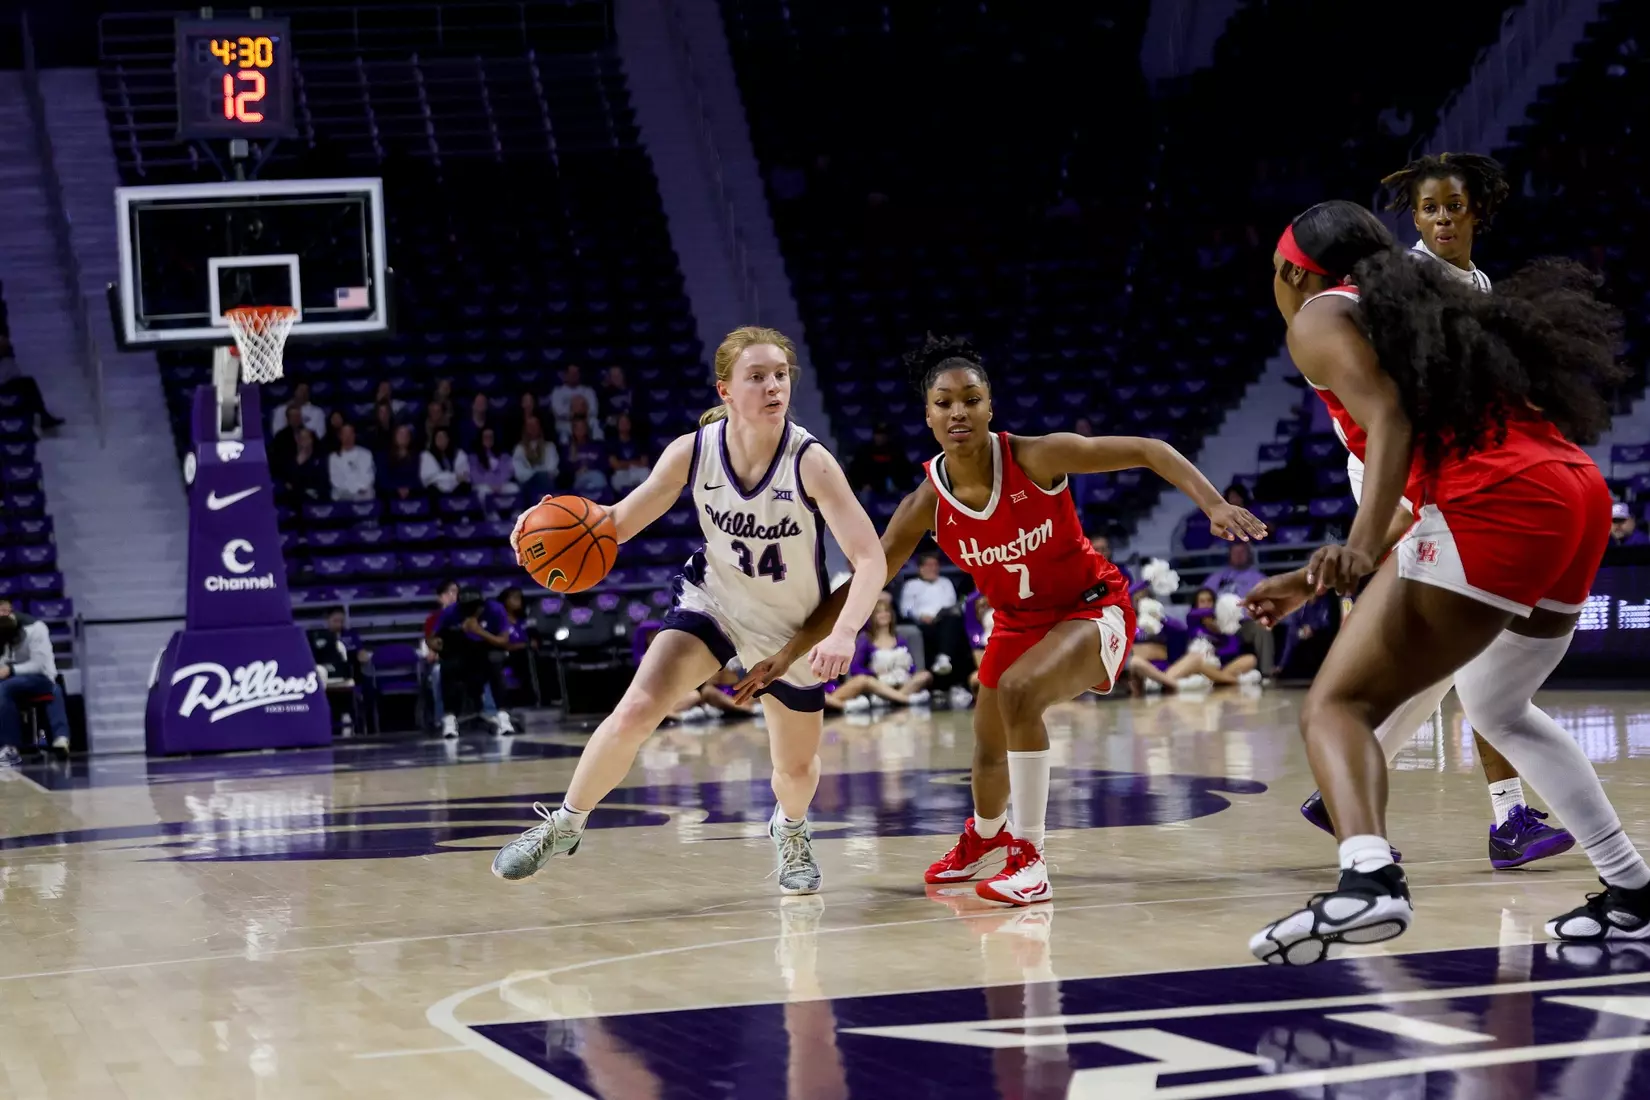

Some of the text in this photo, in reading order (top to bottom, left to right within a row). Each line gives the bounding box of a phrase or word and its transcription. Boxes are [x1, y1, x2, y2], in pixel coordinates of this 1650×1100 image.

[210, 36, 273, 68] 4:30
[223, 70, 266, 122] 12
[704, 503, 803, 541] Wildcats
[958, 518, 1053, 567] Houston
[731, 538, 788, 583] 34
[204, 573, 274, 592] Channel
[1003, 563, 1035, 600] 7
[171, 660, 318, 717] Dillons
